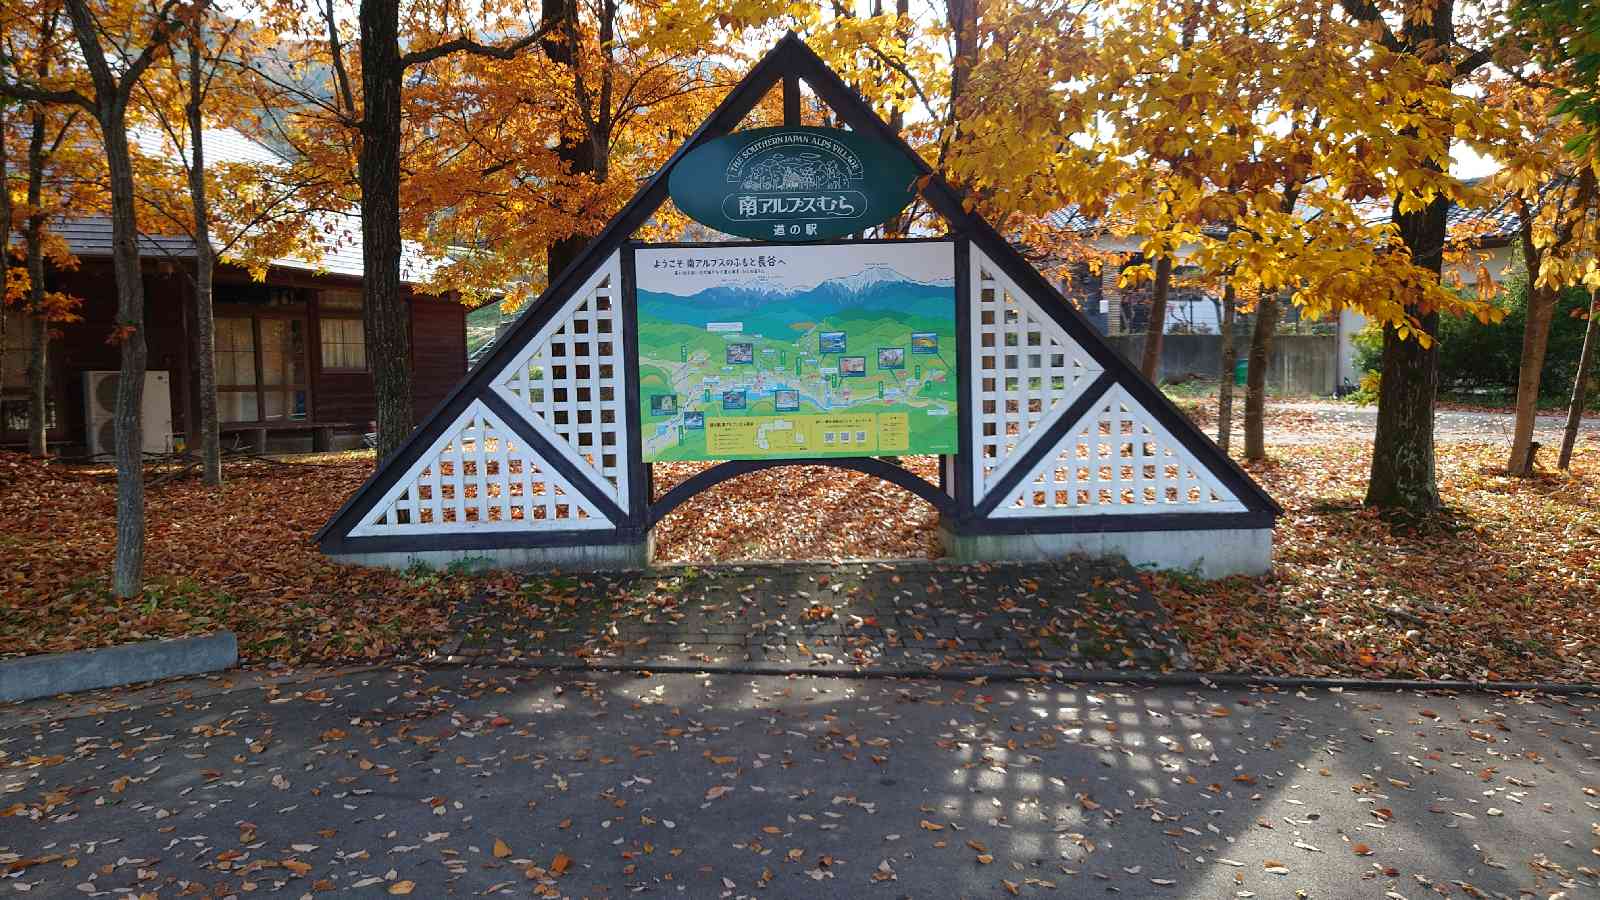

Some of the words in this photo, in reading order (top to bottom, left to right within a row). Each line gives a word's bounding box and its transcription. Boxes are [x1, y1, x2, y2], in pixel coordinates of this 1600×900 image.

[730, 156, 744, 173] THE
[742, 135, 784, 159] SOUTHERN
[785, 134, 809, 145] JAPAN
[812, 137, 832, 149] ALPS
[832, 143, 861, 170] VILLAGE
[737, 195, 856, 218] 南アルプスむら
[773, 223, 818, 237] 道の駅
